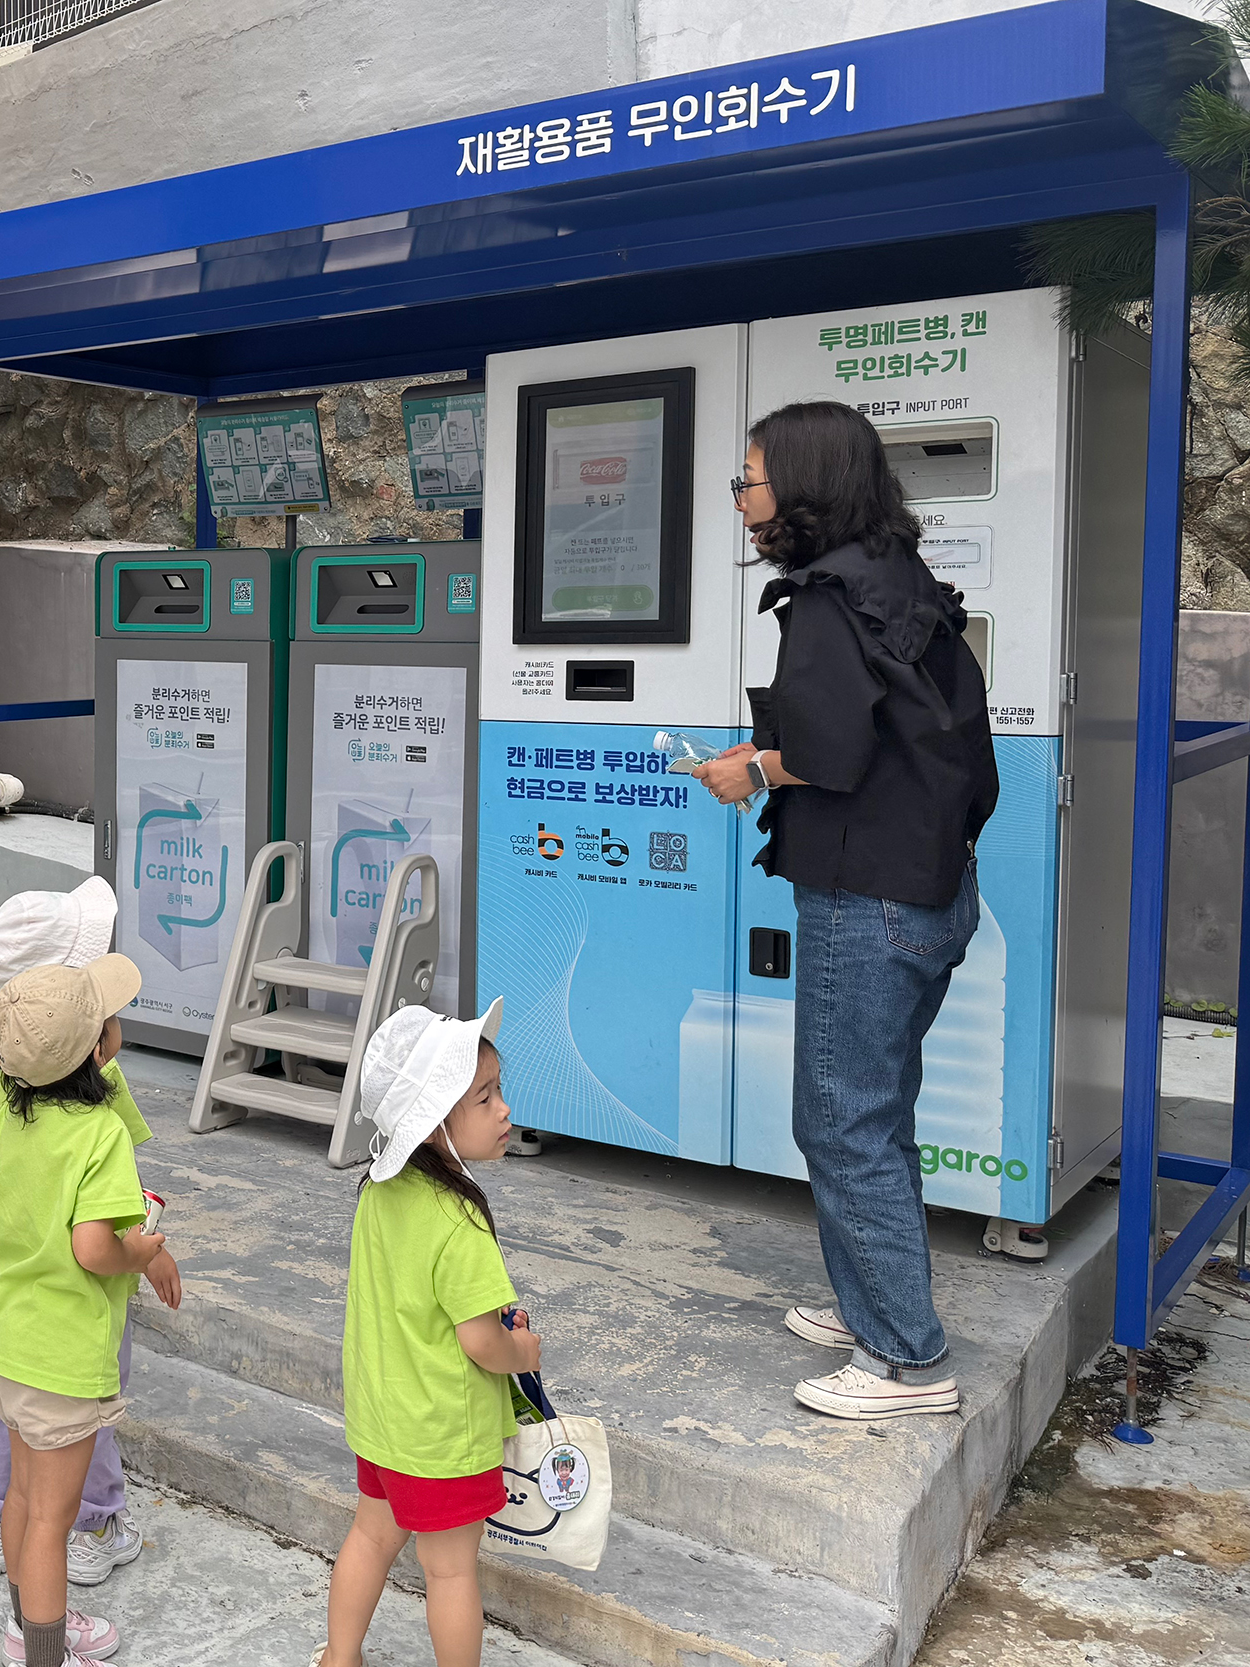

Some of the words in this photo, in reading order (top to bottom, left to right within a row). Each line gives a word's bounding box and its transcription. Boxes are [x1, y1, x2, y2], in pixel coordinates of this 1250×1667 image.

[455, 109, 614, 178] 재활용품
[626, 63, 858, 149] 무인회수기
[817, 314, 956, 352] 투명페트병,
[960, 309, 989, 338] 캔
[834, 347, 968, 384] 무인회수기
[857, 400, 901, 417] 투입구
[905, 399, 938, 414] INPUT
[940, 397, 970, 411] PORT
[921, 514, 948, 527] 세요.
[151, 687, 211, 703] 분리수거하면
[353, 694, 423, 712] 분리수거하면
[133, 703, 166, 720] 즐거운
[167, 705, 201, 722] 포인트
[203, 707, 231, 724] 적립!
[996, 716, 1035, 725] 1551-1557
[1000, 706, 1035, 716] 신고전화
[332, 712, 370, 730] 즐거운
[372, 715, 411, 732] 포인트
[414, 716, 446, 735] 적립!
[602, 750, 691, 776] 투입하
[506, 777, 587, 803] 현금으로
[594, 782, 689, 810] 보상받자!
[159, 835, 203, 860] milk
[510, 834, 535, 845] cash
[575, 840, 600, 851] cash
[512, 844, 535, 856] bee
[577, 850, 599, 862] bee
[144, 861, 214, 887] carton
[544, 870, 558, 878] 카드
[683, 882, 698, 892] 카드
[166, 892, 193, 909] 종이팩
[343, 886, 422, 915] carn
[918, 1143, 1029, 1182] garoo
